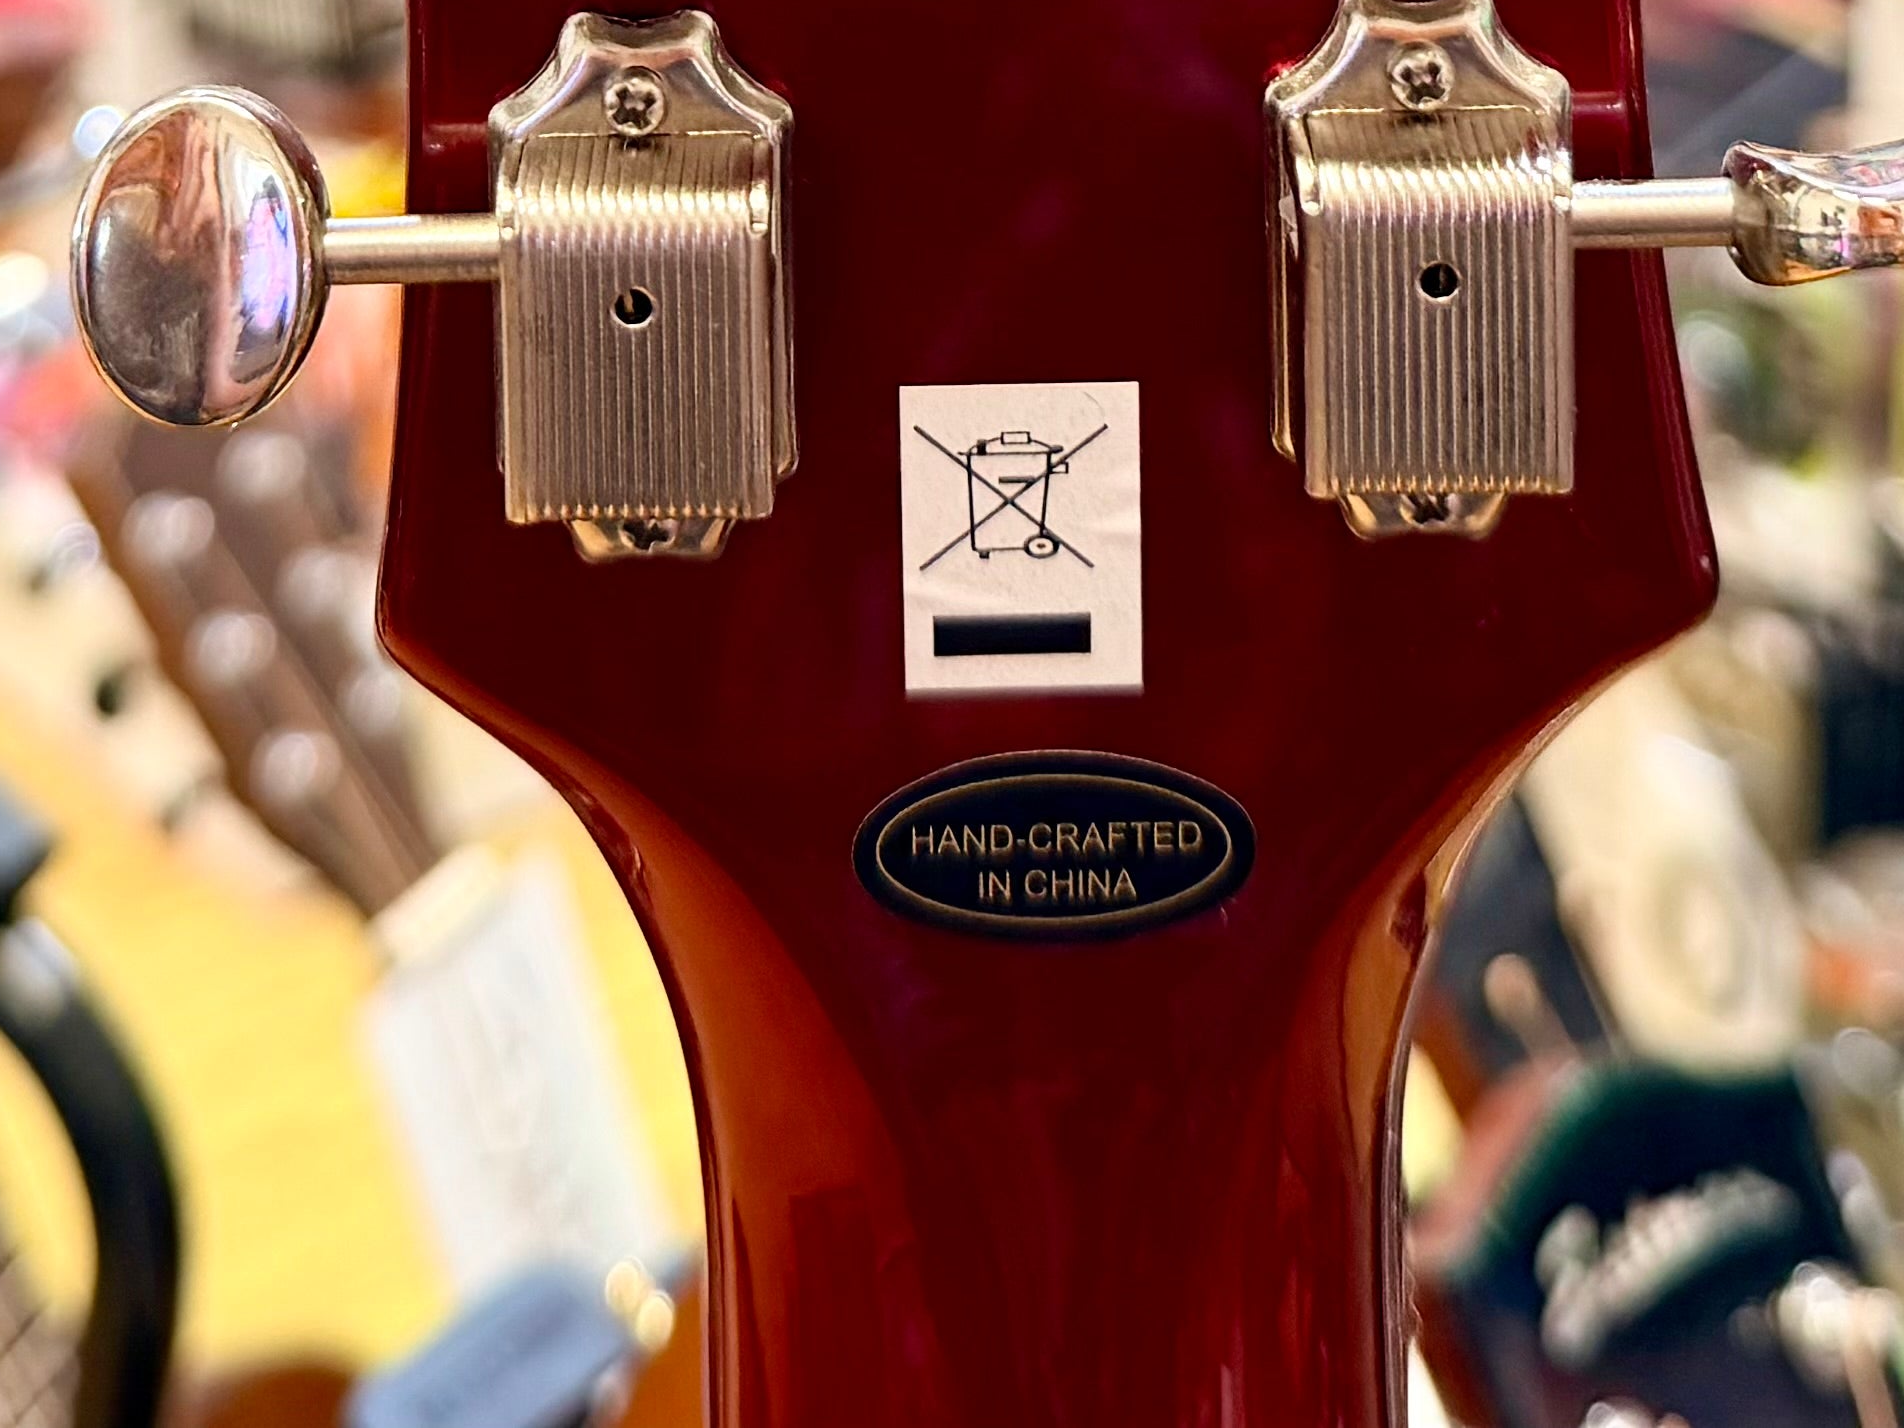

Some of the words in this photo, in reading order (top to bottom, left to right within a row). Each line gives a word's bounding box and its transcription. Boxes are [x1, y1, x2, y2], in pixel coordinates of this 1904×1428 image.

[910, 820, 1203, 856] HAND-CRAFTED
[978, 868, 1011, 900] IN
[1023, 867, 1138, 900] CHINA
